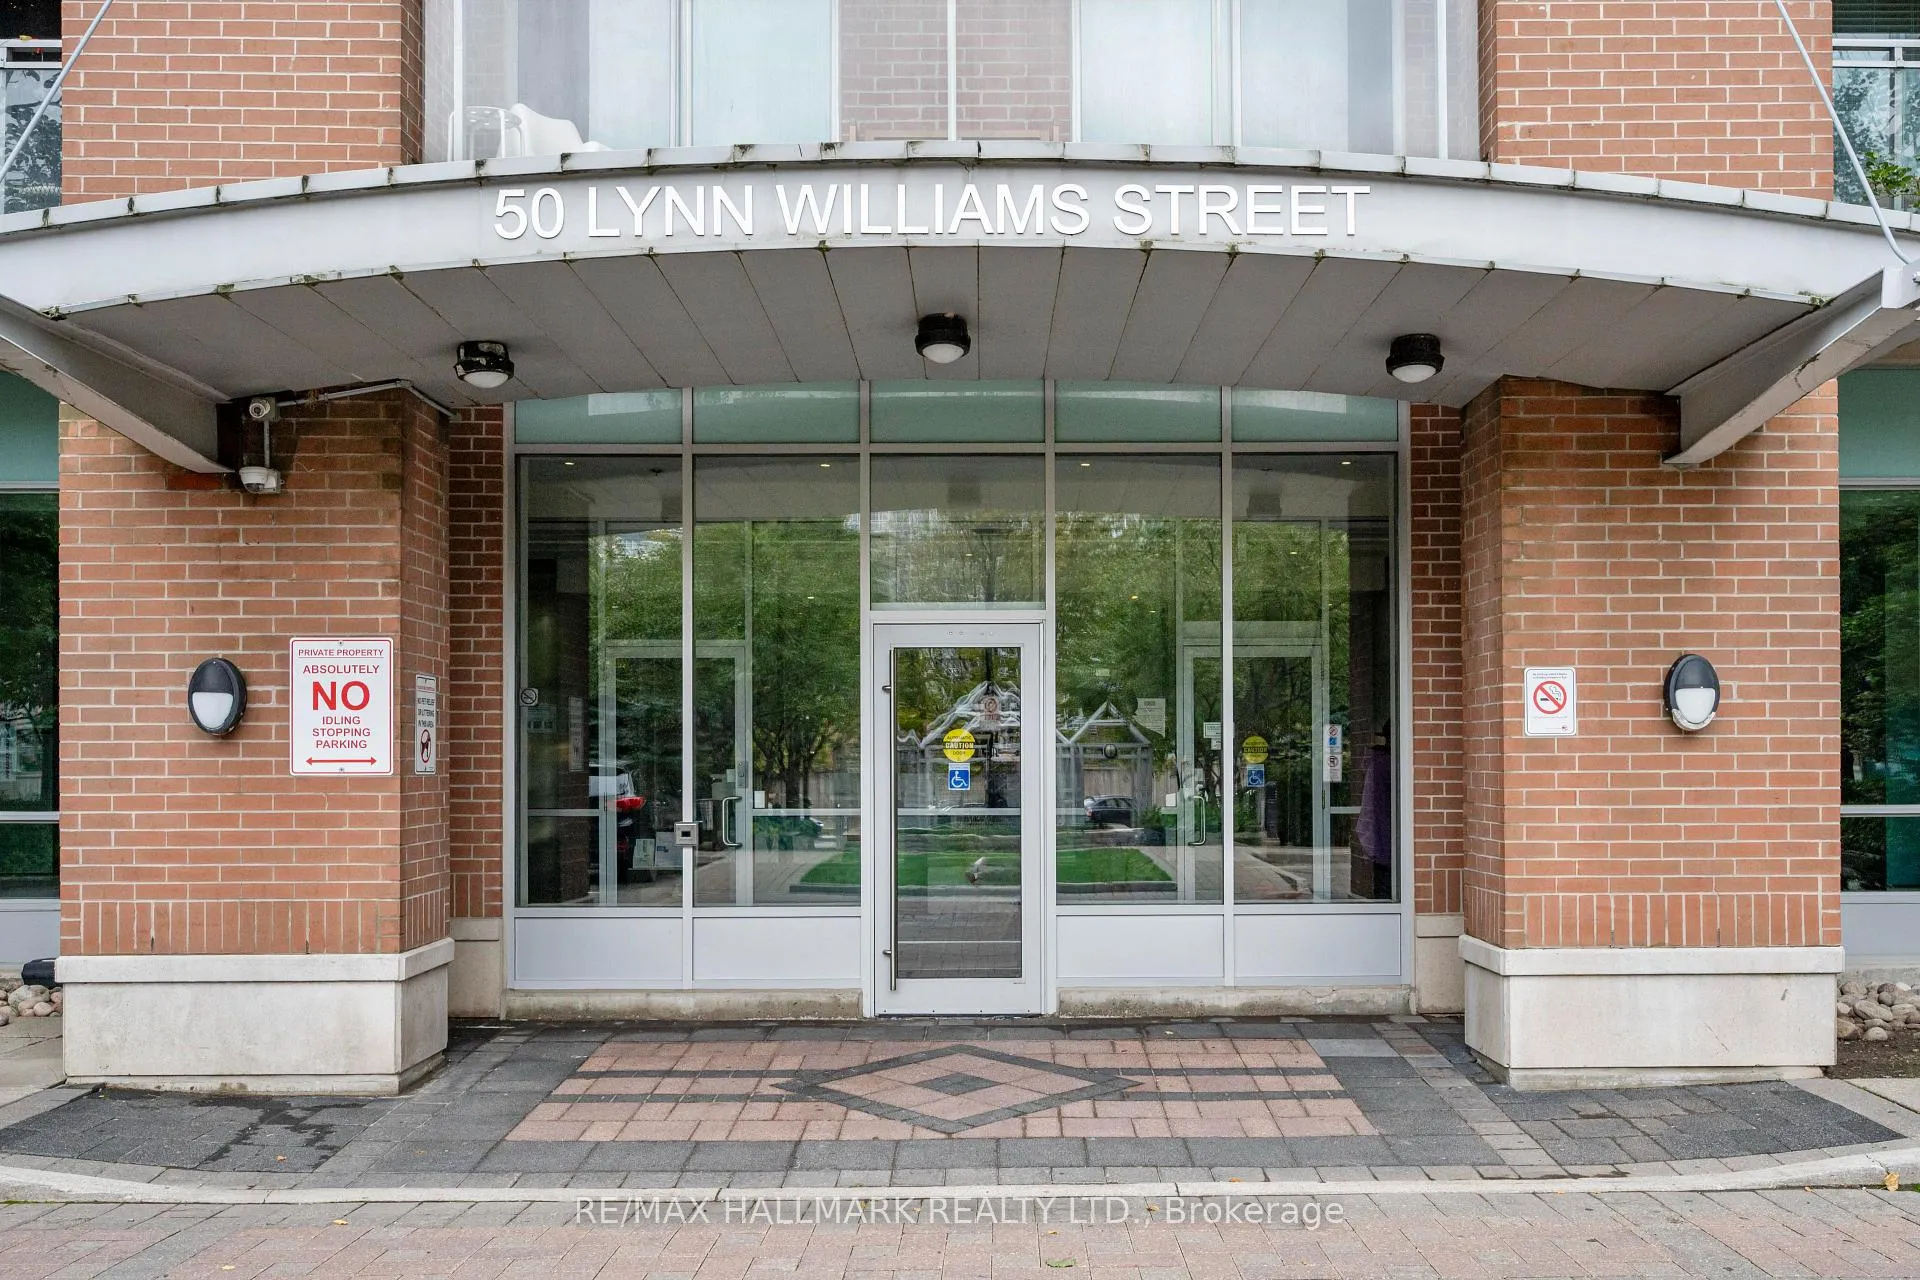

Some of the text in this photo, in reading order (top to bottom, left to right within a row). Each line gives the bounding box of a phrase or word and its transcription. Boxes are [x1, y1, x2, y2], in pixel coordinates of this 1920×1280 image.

[493, 183, 1371, 241] 50 LYNN WILLIAMS STREET
[303, 665, 380, 674] ABSOLUTELY
[312, 681, 370, 711] NO
[322, 716, 361, 725] IDLING
[312, 728, 371, 737] STOPPING
[316, 740, 368, 749] PARKING
